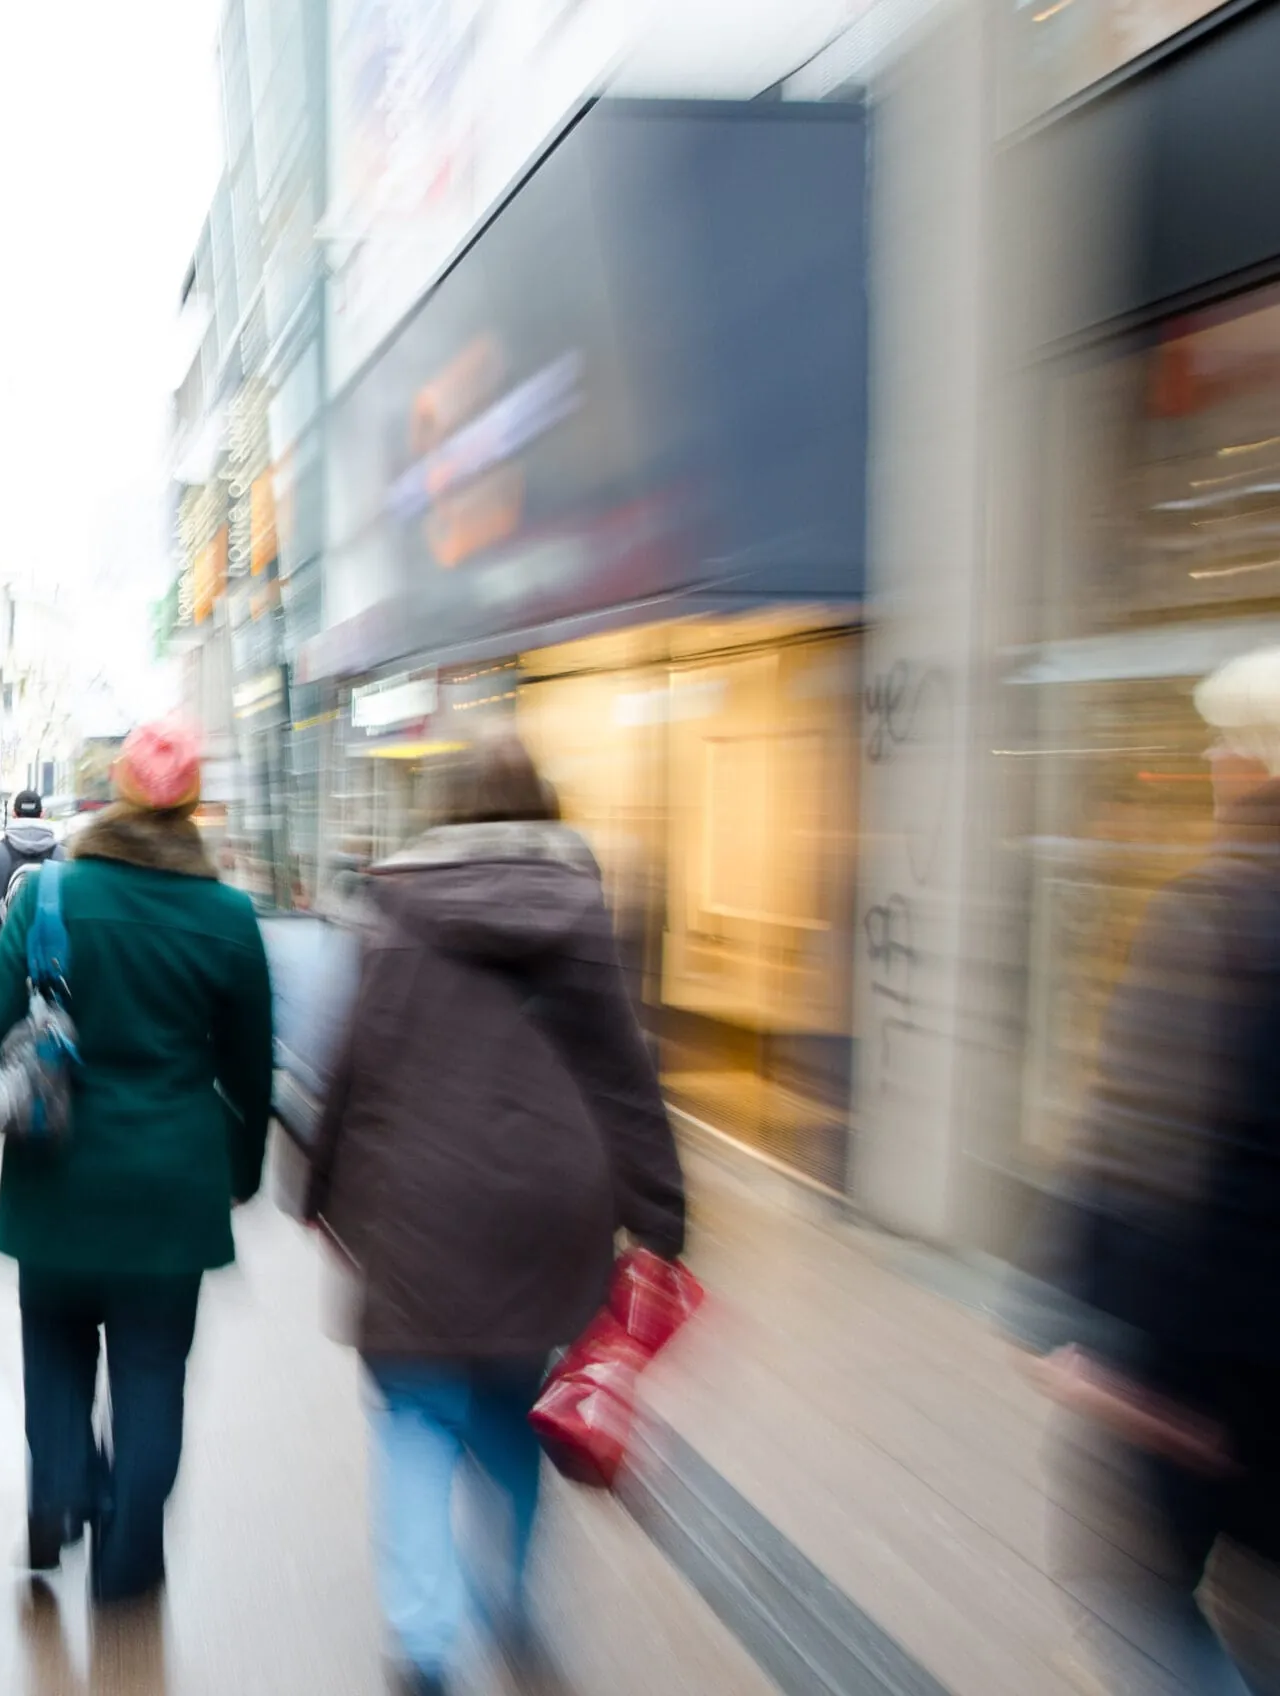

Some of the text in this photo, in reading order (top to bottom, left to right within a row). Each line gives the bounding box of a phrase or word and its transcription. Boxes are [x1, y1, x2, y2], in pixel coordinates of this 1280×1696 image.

[218, 472, 245, 498] of
[218, 507, 249, 577] home
[173, 575, 194, 626] home
